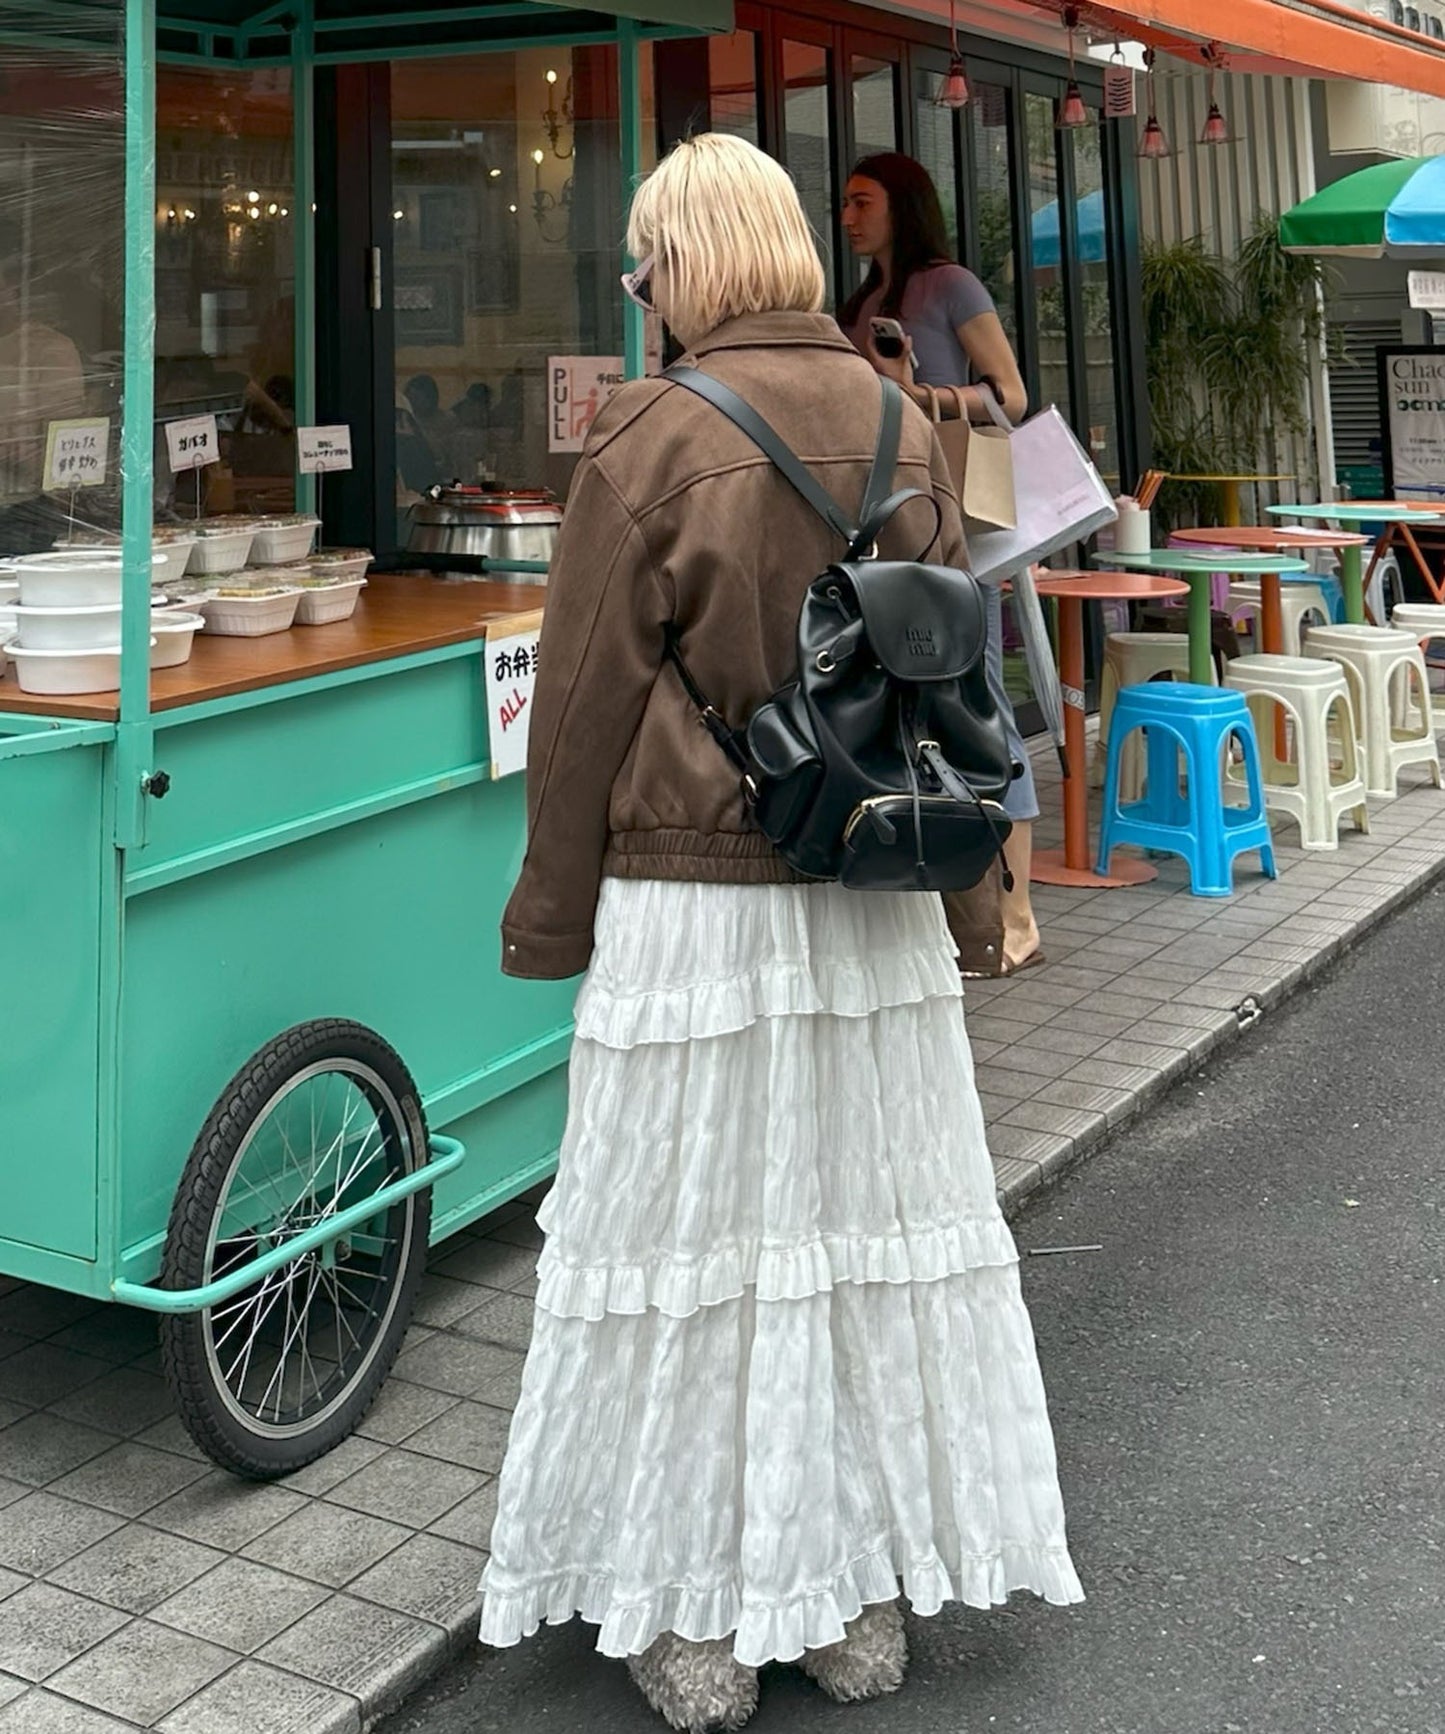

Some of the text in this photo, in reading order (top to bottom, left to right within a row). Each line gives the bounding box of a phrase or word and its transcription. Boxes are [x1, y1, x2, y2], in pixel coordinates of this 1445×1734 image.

[553, 367, 568, 440] PULL
[1394, 380, 1430, 394] sun
[499, 687, 527, 732] ALL
